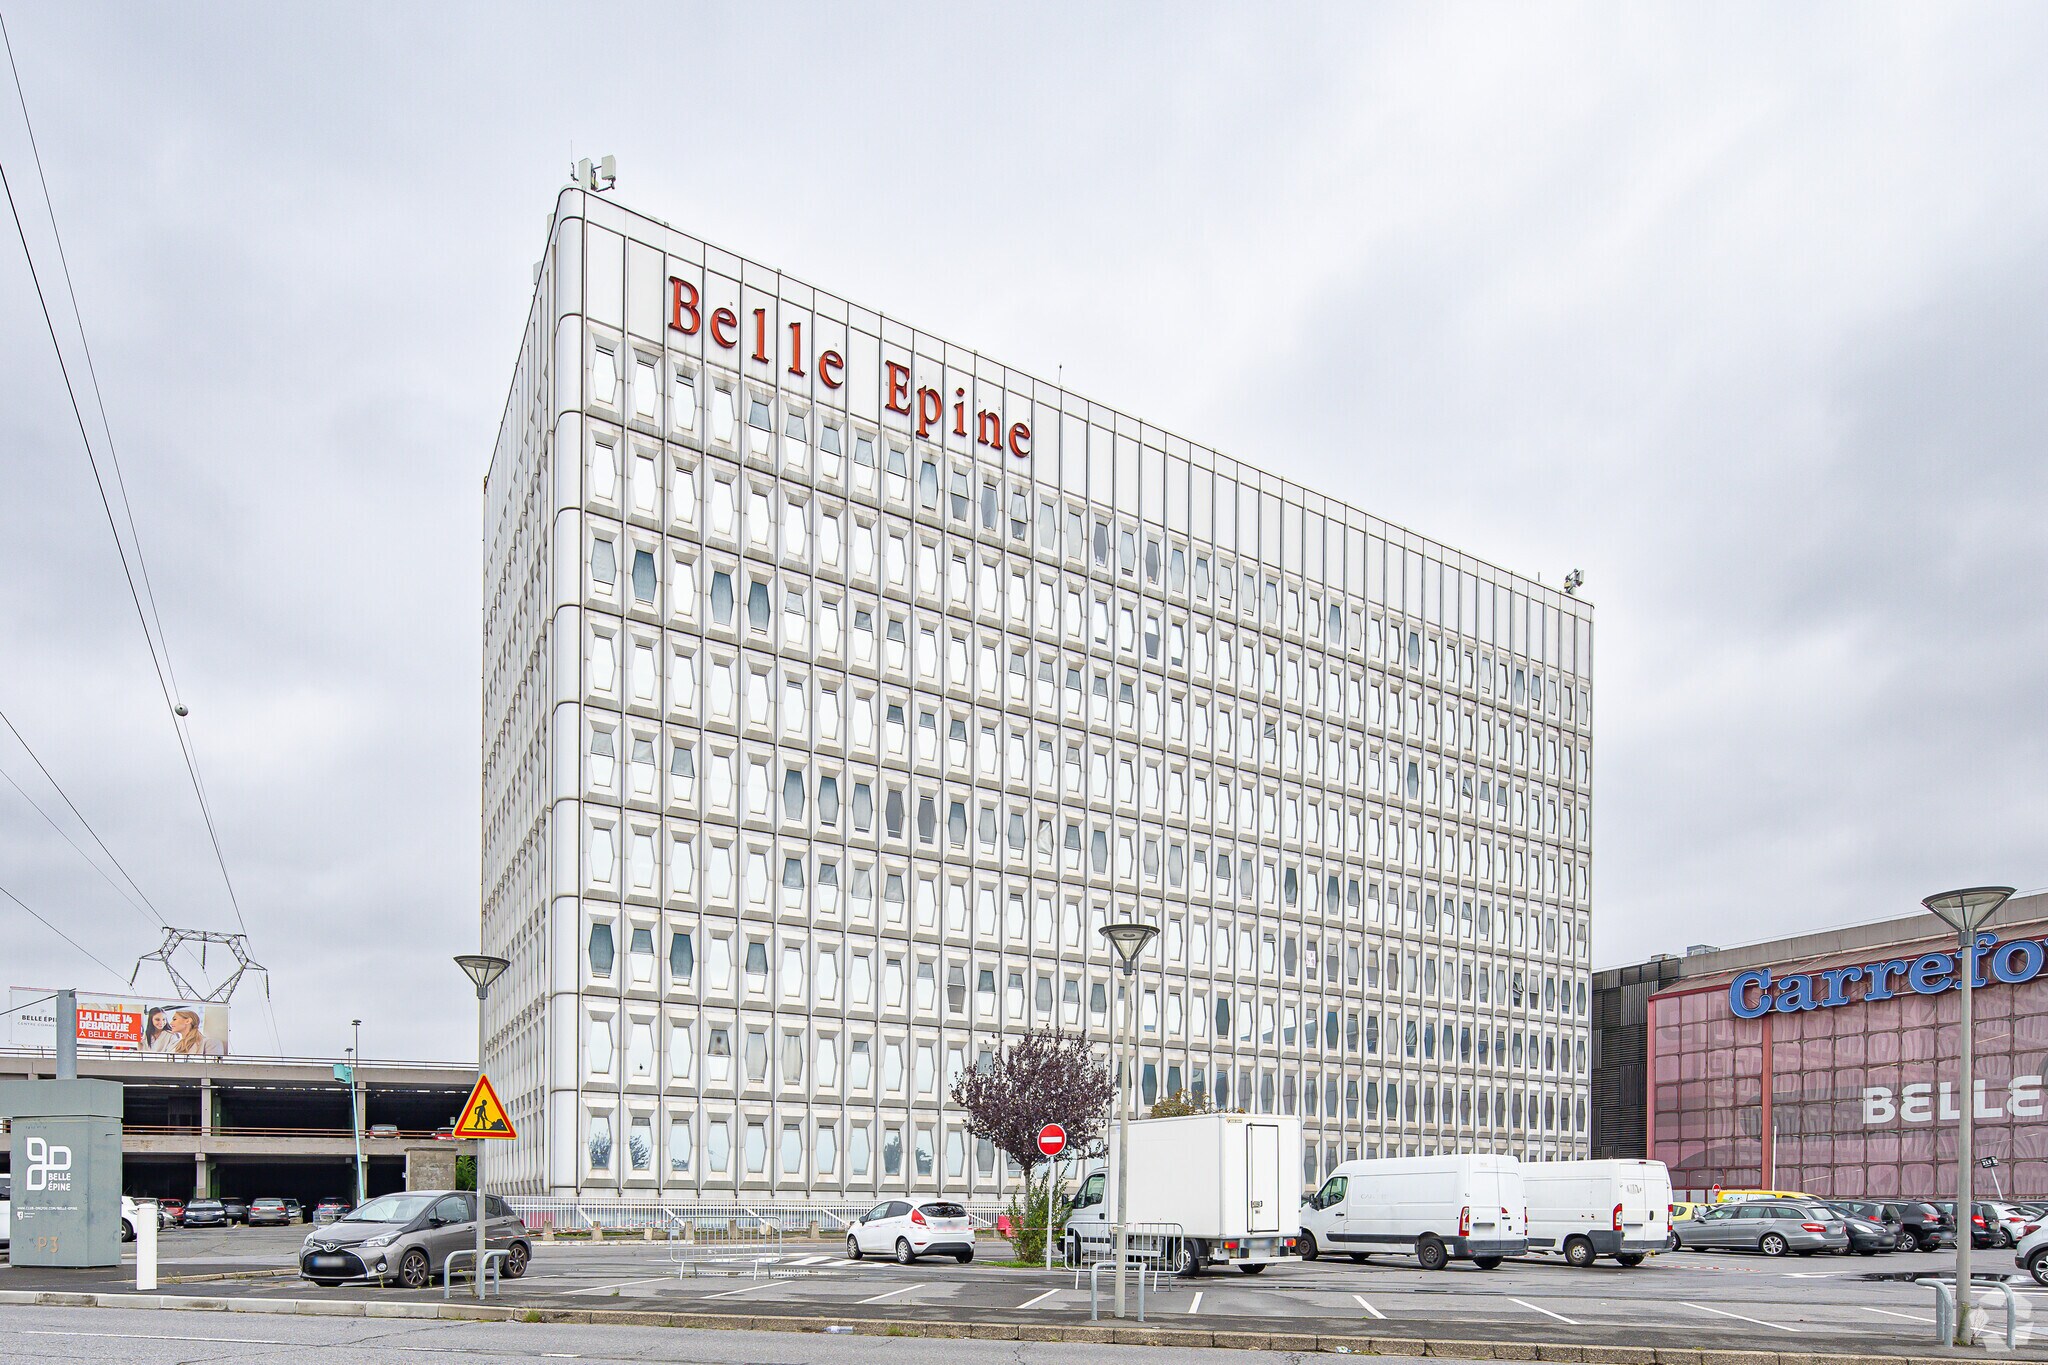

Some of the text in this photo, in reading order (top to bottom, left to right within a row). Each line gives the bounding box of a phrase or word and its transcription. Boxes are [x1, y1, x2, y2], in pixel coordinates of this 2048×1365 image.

[667, 275, 1031, 458] Belle Epine
[1729, 931, 2048, 1019] Carrefo
[21, 1014, 57, 1023] BELLE ÉPI
[79, 1011, 133, 1024] LA LIGNE 14
[79, 1029, 138, 1041] À BELLE ÉPINE
[1863, 1075, 2043, 1124] BELLE
[48, 1180, 71, 1191] ÉPINE
